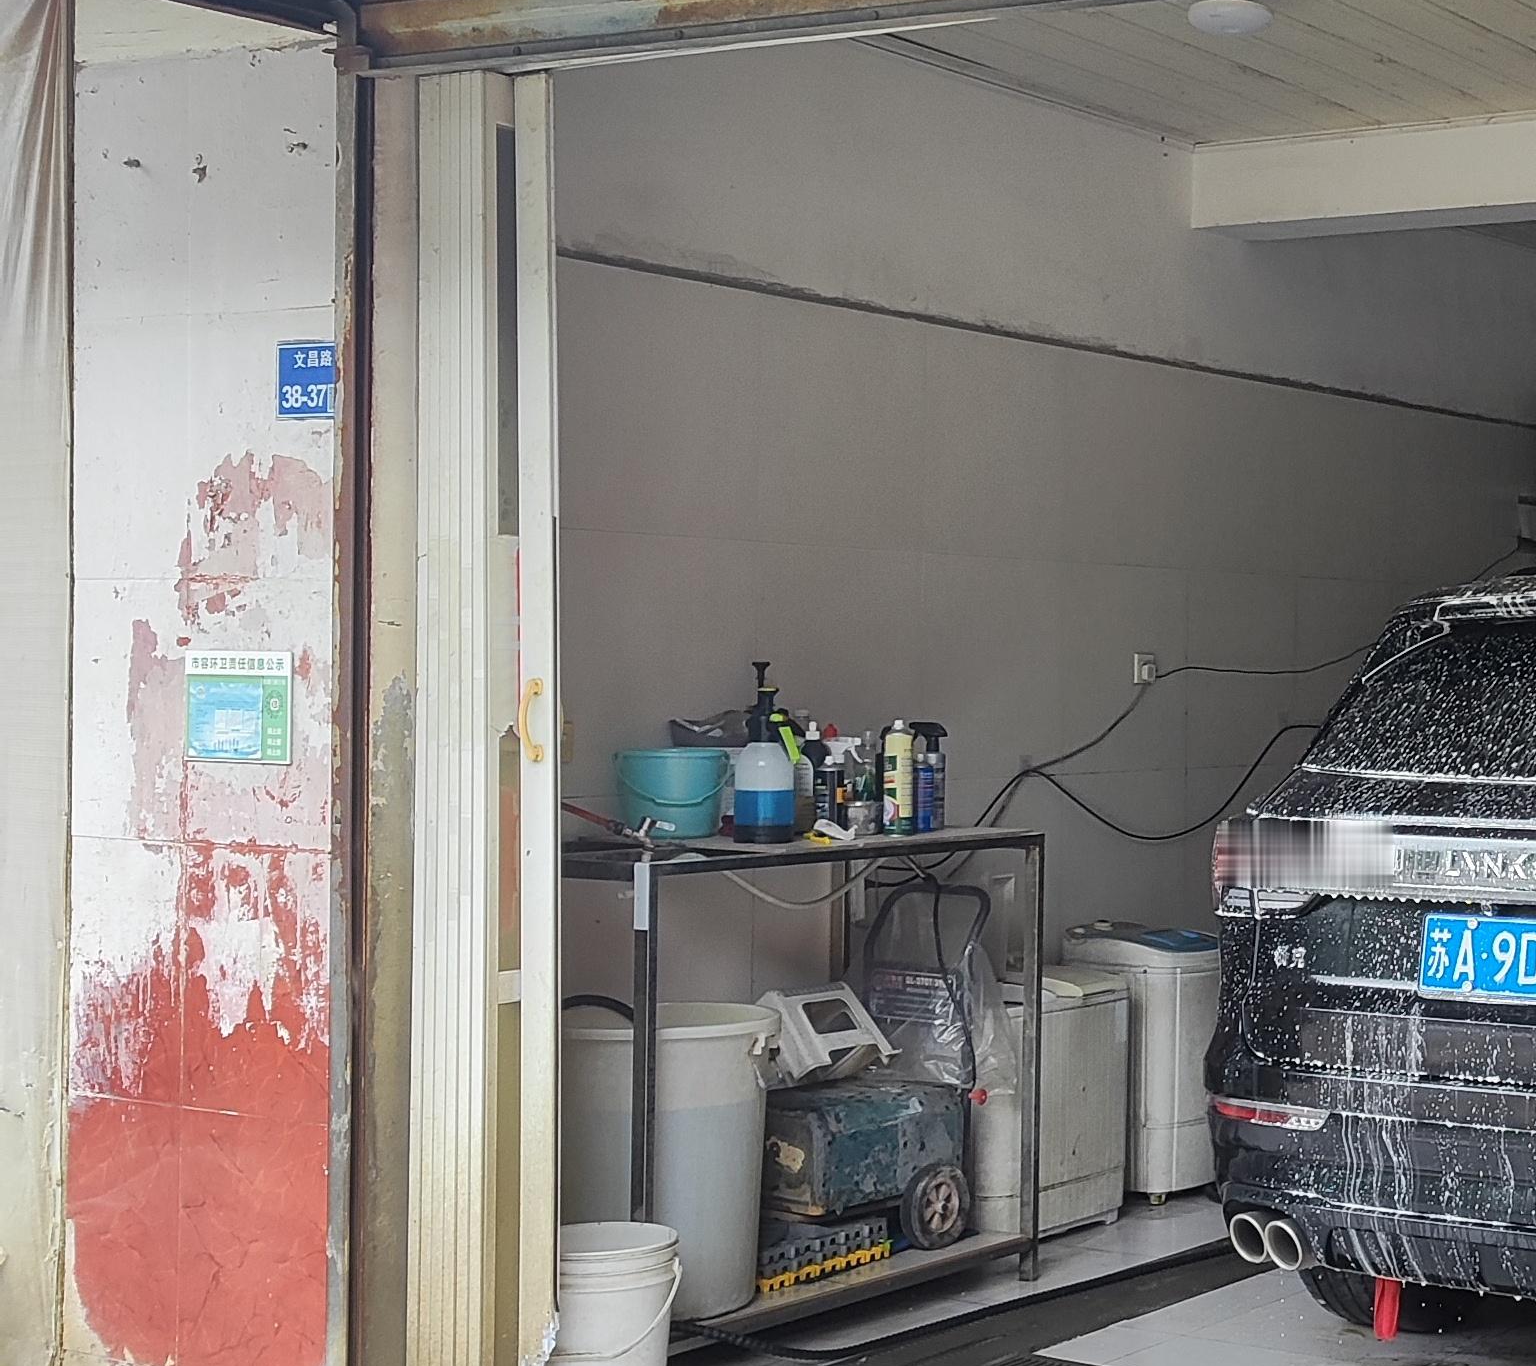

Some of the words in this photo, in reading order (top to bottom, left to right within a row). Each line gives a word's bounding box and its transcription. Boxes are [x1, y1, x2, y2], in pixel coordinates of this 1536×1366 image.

[293, 349, 333, 369] 文昌路
[281, 384, 328, 409] 38-37
[191, 657, 285, 671] 市容环卫责任信息公示
